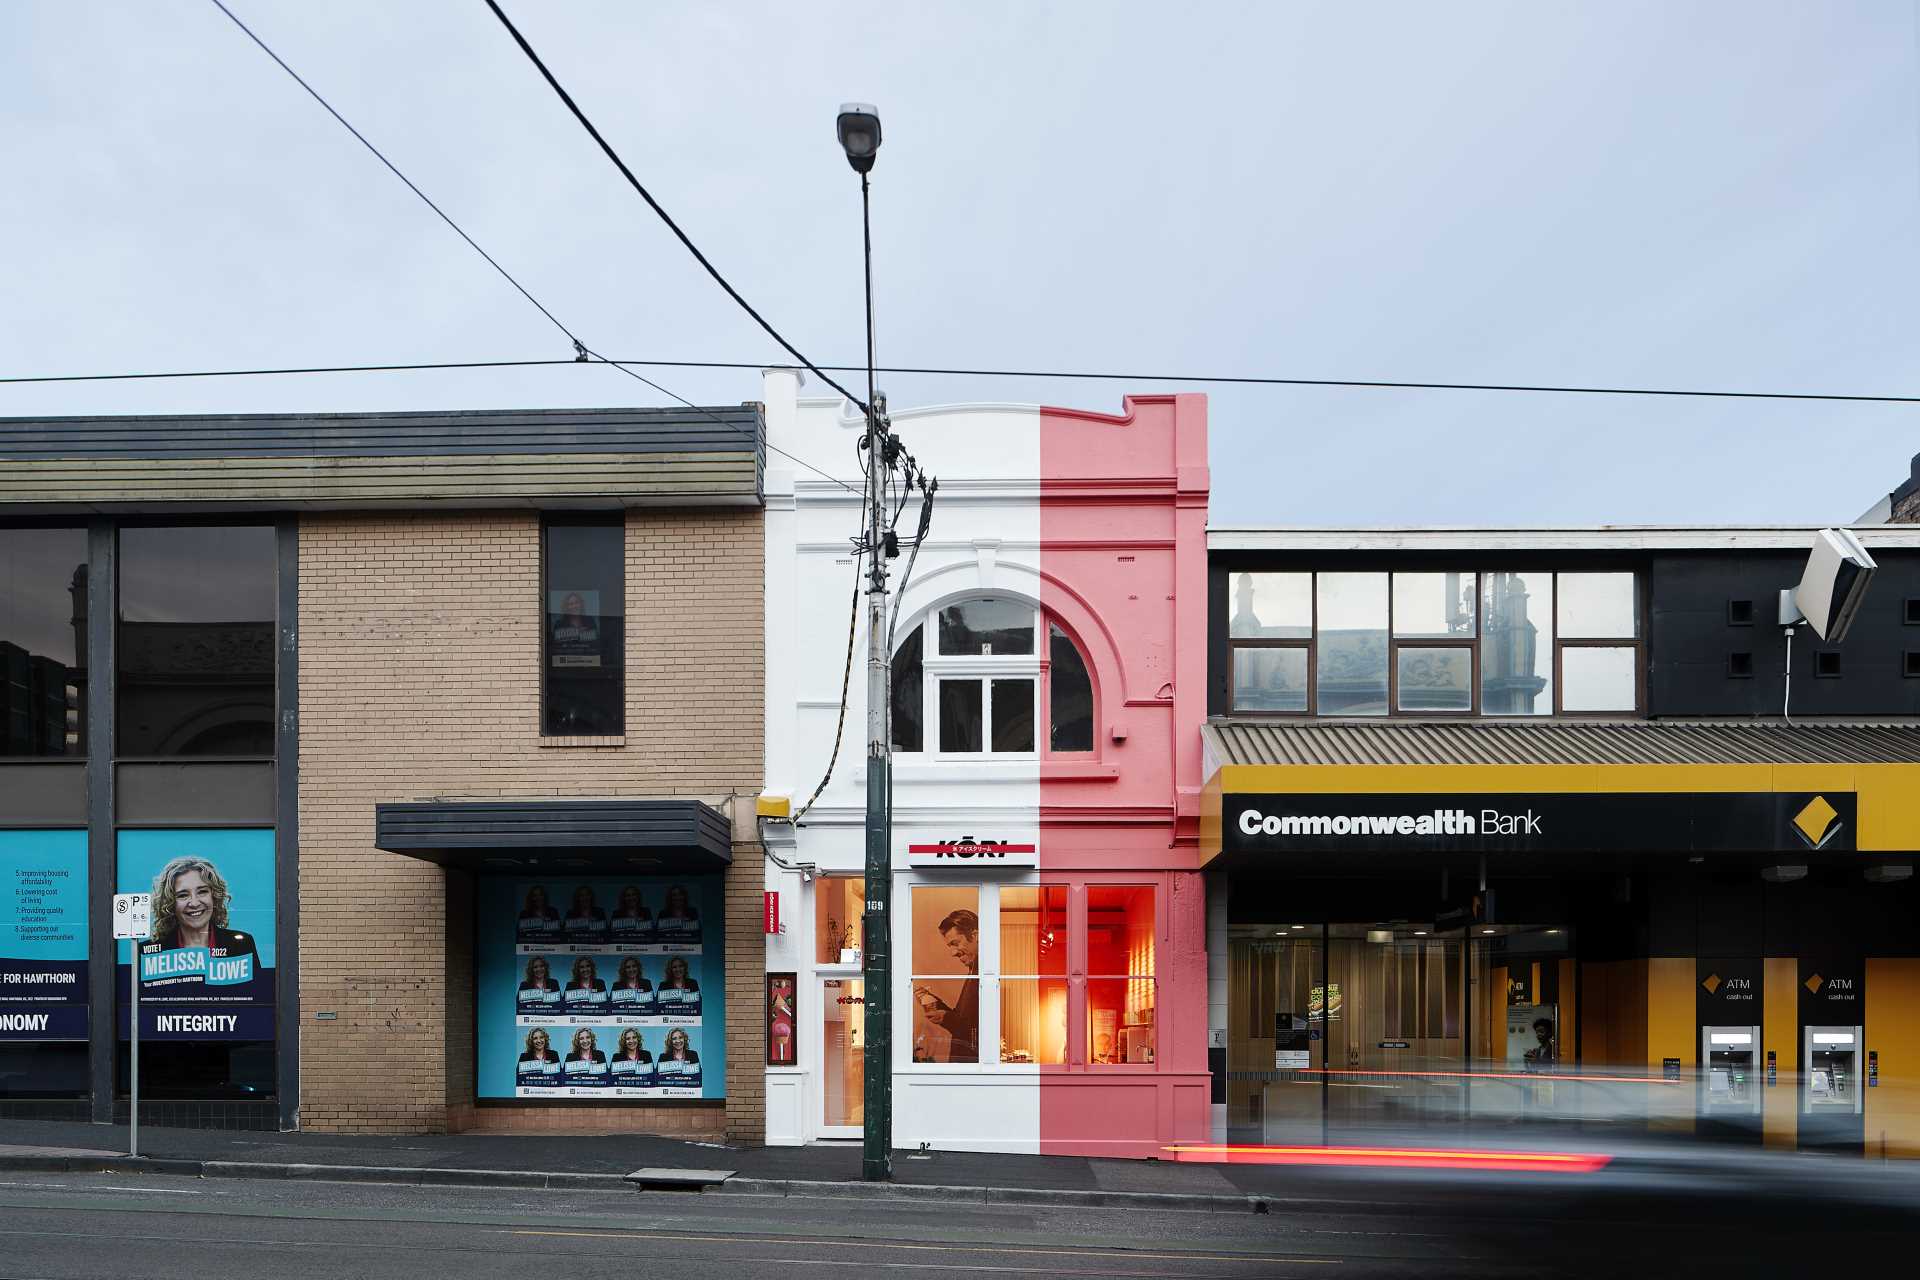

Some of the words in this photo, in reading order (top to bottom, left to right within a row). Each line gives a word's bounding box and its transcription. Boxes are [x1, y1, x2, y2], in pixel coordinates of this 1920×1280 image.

[1239, 809, 1476, 835] Commonwealth
[1481, 809, 1542, 835] Bank
[48, 870, 69, 878] housing
[132, 896, 140, 907] P
[21, 907, 45, 915] Providing
[46, 907, 64, 915] quality
[143, 945, 158, 954] VOTE
[211, 948, 227, 957] 2022
[145, 951, 206, 976] MELISSA
[209, 959, 249, 981] LOWE
[3, 973, 21, 984] FOR
[23, 973, 76, 984] HAWTHORN
[1726, 979, 1750, 989] ATM
[1828, 979, 1852, 989] ATM
[157, 1015, 238, 1032] INTEGRITY
